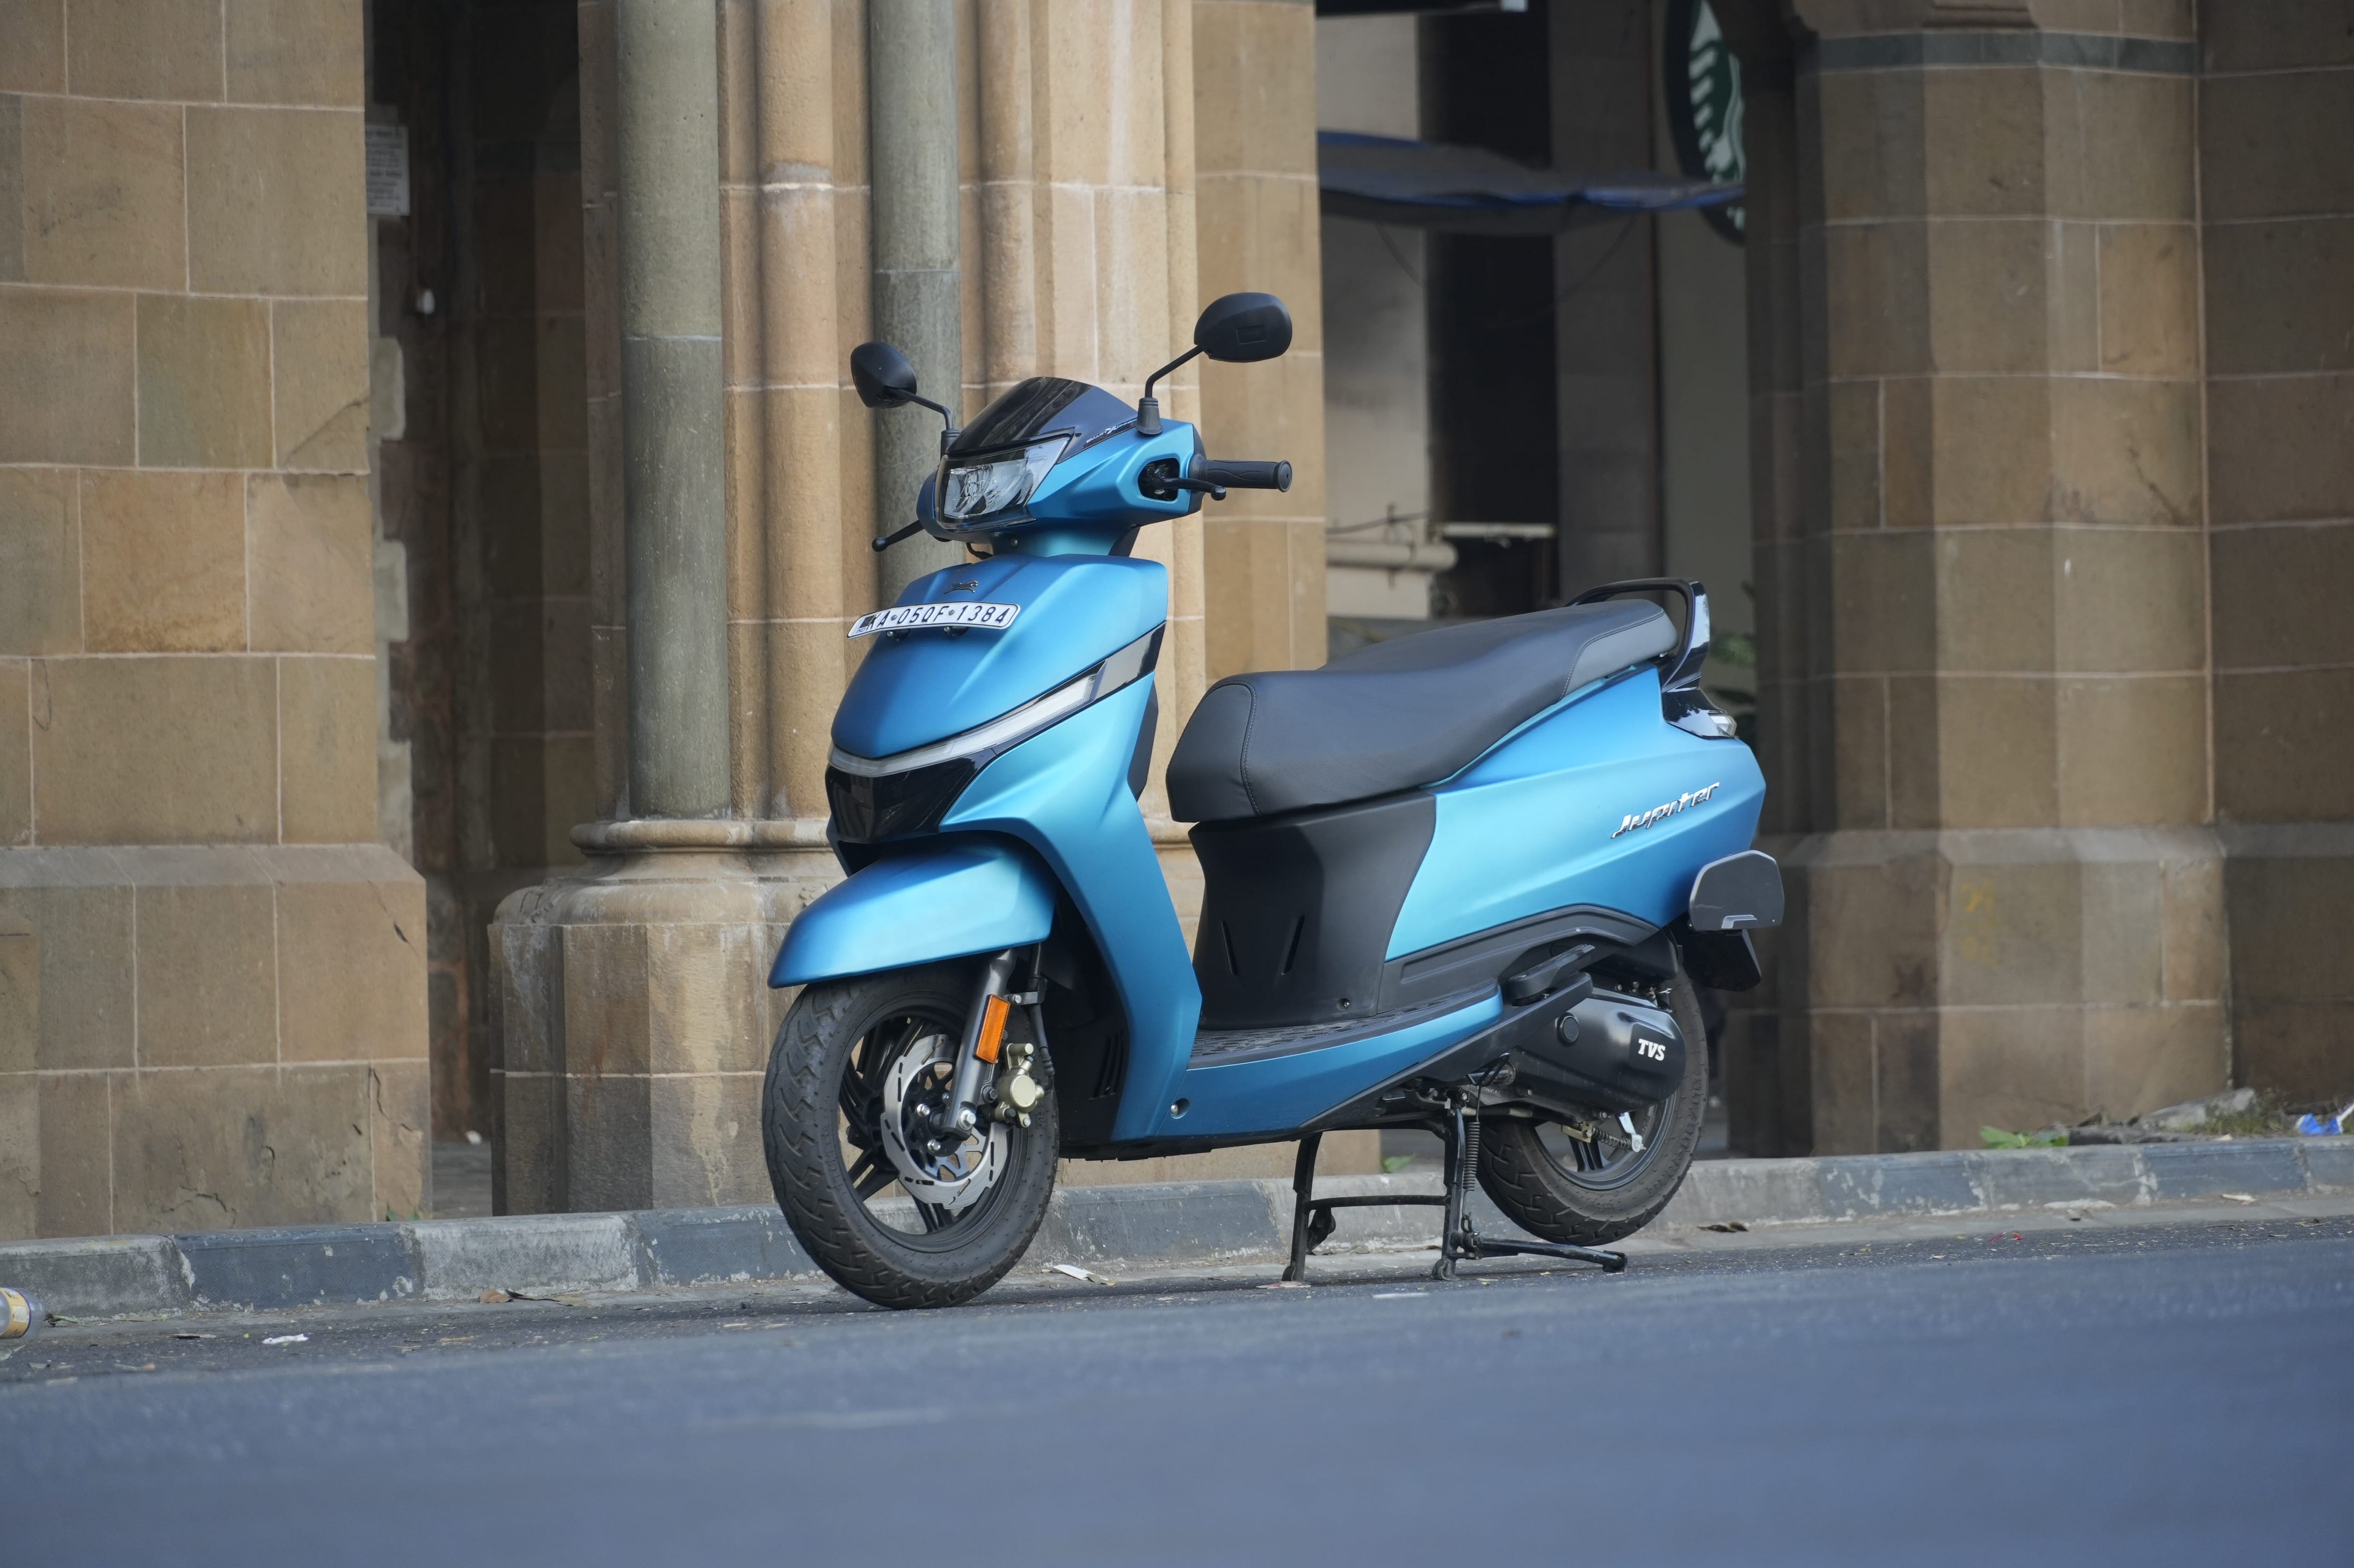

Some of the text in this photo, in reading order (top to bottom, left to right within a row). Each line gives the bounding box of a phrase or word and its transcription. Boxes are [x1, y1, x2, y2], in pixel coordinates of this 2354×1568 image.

[866, 611, 891, 630] KA
[957, 605, 1010, 623] 1384
[1638, 1039, 1666, 1061] TVS
